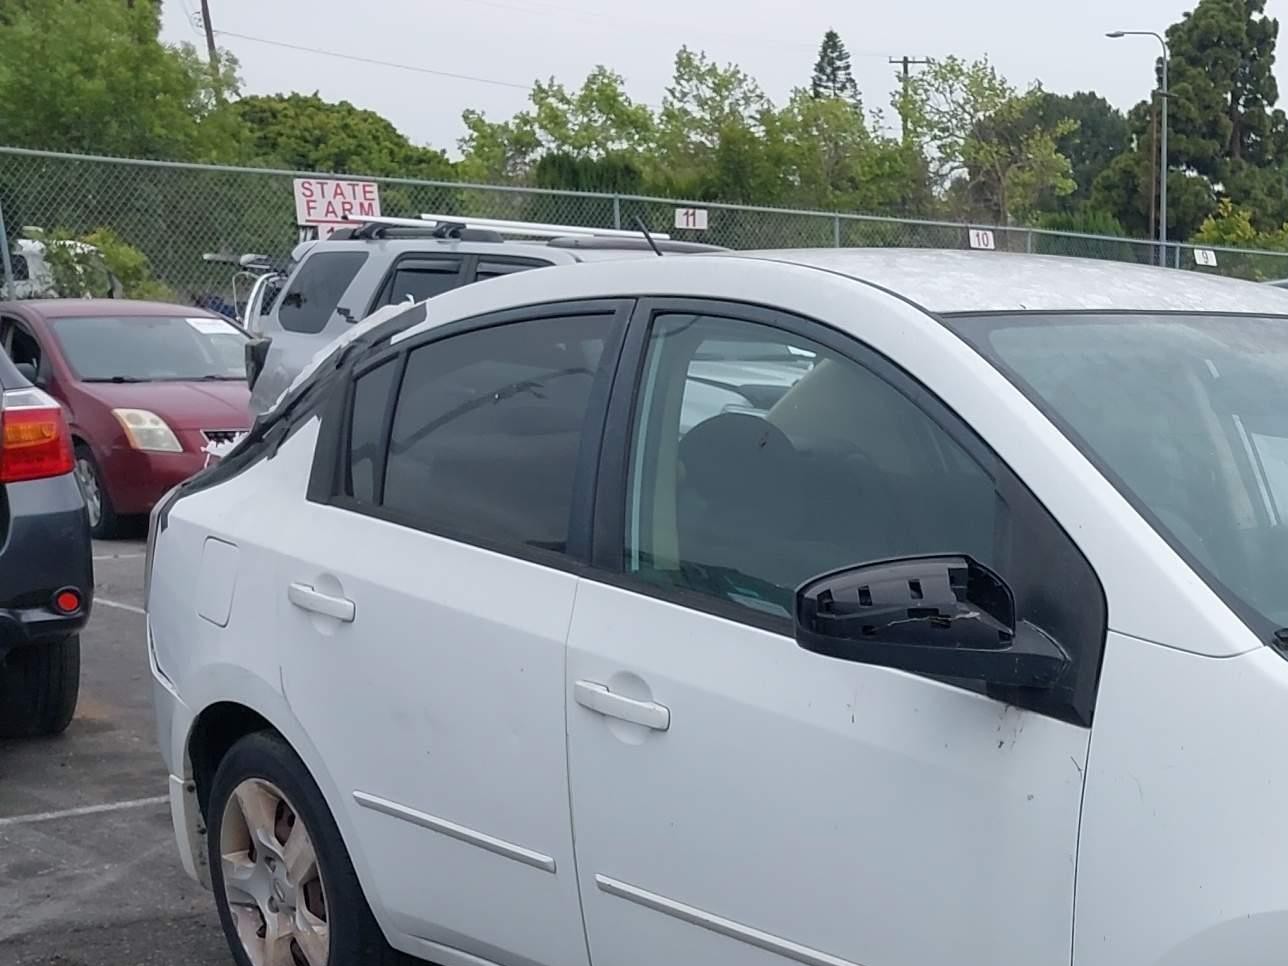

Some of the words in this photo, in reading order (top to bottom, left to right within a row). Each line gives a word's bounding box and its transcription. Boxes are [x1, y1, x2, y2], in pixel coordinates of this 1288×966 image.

[301, 181, 375, 201] STATE
[306, 200, 375, 218] FARM
[683, 210, 696, 227] 11
[976, 231, 989, 248] 10
